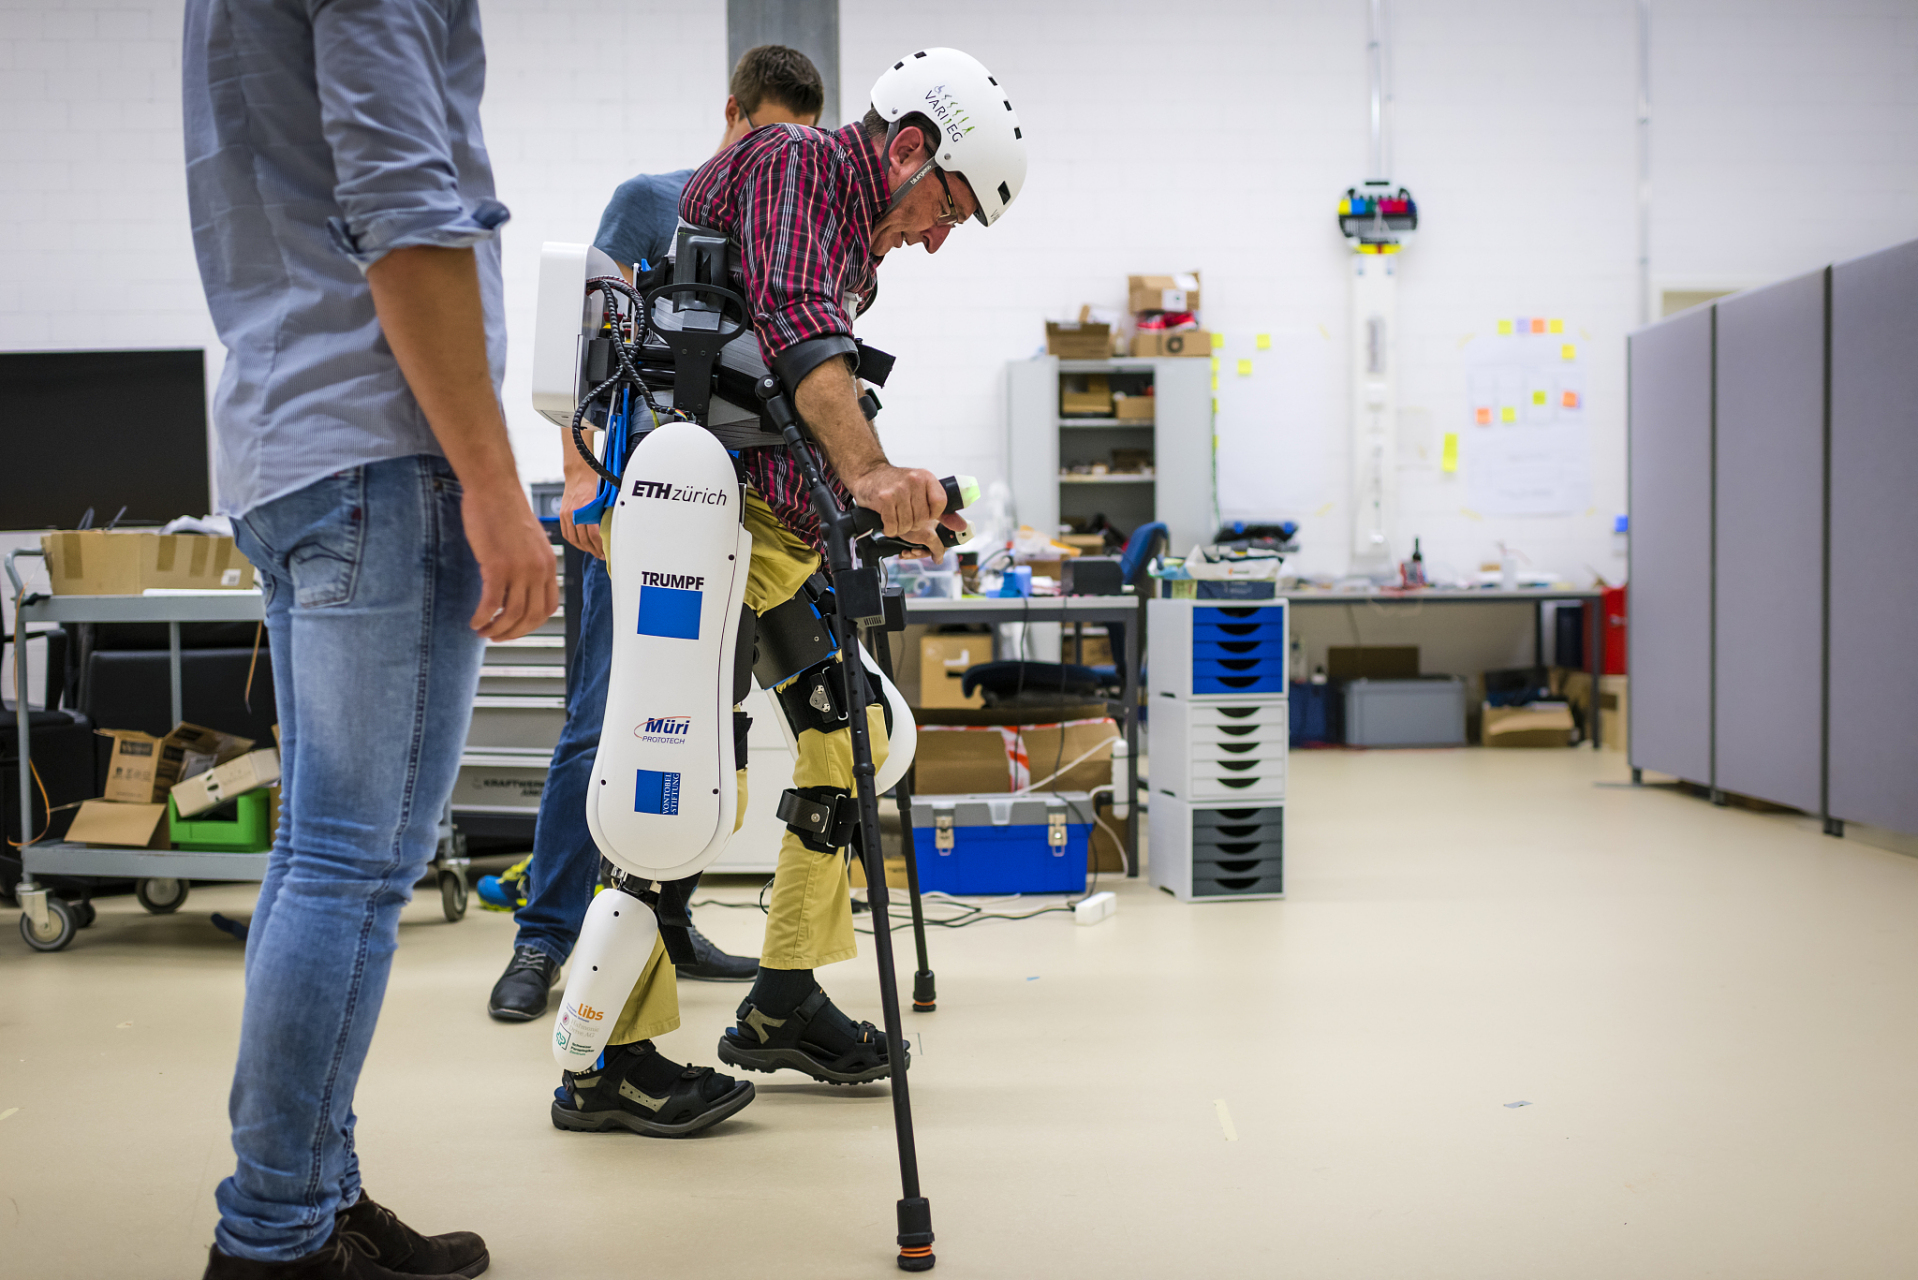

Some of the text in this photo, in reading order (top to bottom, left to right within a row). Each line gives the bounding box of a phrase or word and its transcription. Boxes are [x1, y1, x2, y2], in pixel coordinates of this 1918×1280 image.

[641, 571, 704, 590] TRUMPF
[645, 717, 690, 734] Müri
[642, 736, 685, 744] PROTOTECH
[663, 773, 672, 814] VONTOBEL
[578, 1003, 604, 1020] libs
